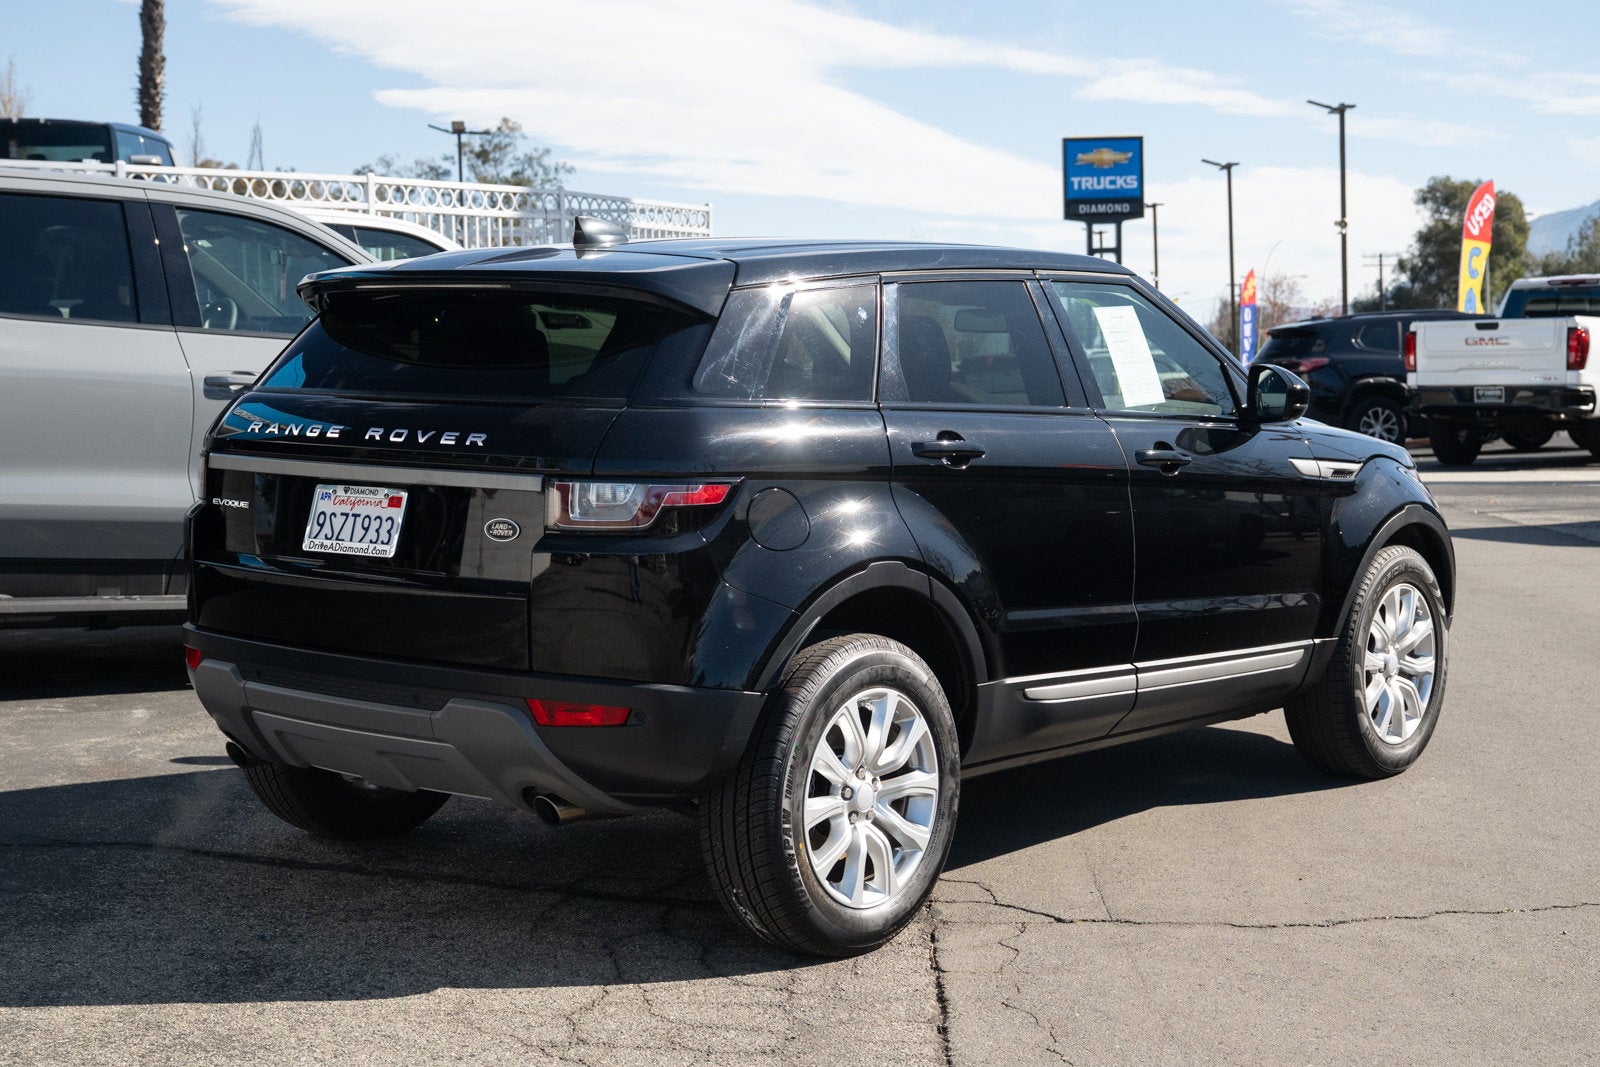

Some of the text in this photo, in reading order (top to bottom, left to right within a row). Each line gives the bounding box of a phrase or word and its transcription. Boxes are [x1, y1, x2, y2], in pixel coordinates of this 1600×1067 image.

[1070, 175, 1139, 190] TRUCKS
[1078, 203, 1131, 214] DIAMOND
[1467, 194, 1495, 235] USED
[1465, 337, 1510, 346] GMC
[247, 421, 488, 447] RANGE ROVER
[320, 492, 332, 501] APR
[350, 487, 379, 496] DIAMOND
[212, 497, 250, 509] EVOQUE
[332, 495, 388, 511] California
[313, 511, 394, 545] 9SZT933
[308, 540, 388, 555] DriveADiamond.com
[782, 807, 794, 851] PAW
